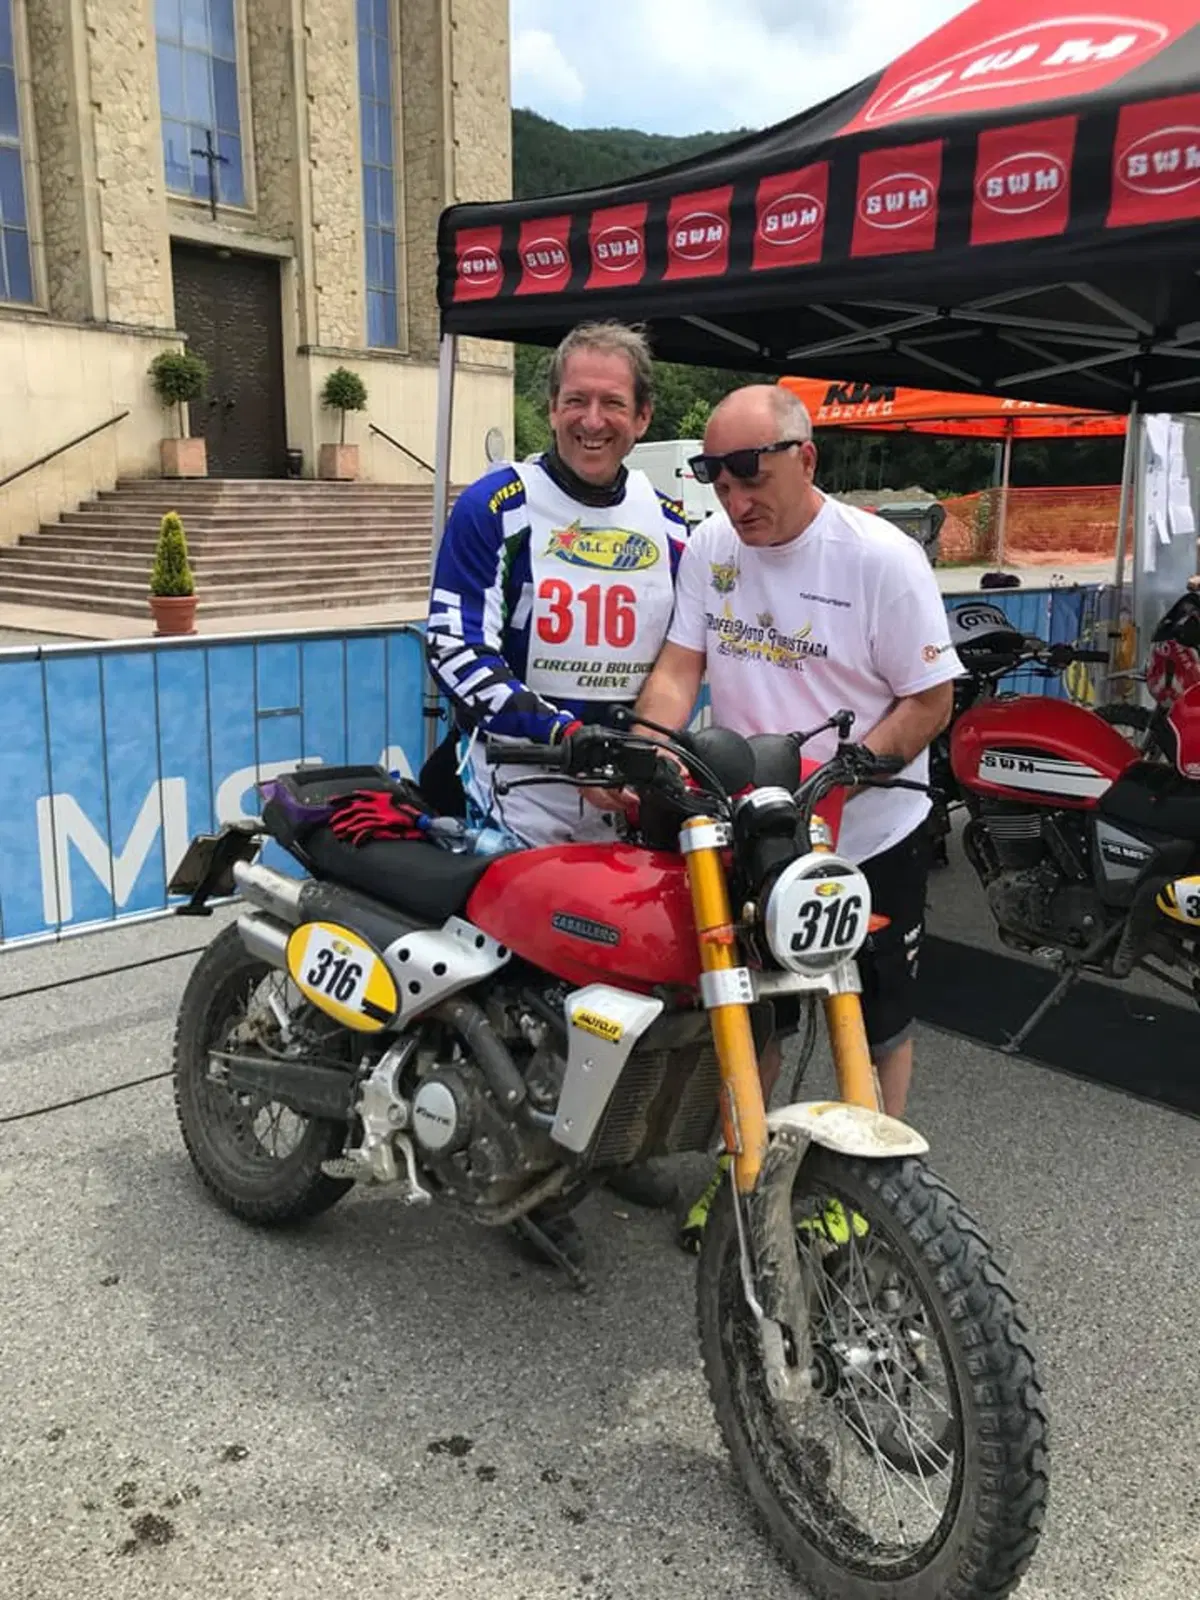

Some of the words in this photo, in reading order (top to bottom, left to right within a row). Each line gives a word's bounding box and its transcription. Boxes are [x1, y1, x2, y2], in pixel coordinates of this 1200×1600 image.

[986, 169, 1059, 198] SWM
[866, 188, 928, 214] SWM
[765, 207, 817, 233] SWM
[675, 225, 723, 248] SWM
[525, 249, 565, 268] SWM
[597, 239, 639, 259] SWM
[462, 258, 498, 274] SWM
[536, 578, 637, 648] 316
[533, 659, 603, 674] CIRCOLO
[576, 674, 630, 688] CHIEVE
[984, 756, 1034, 773] SWM
[790, 895, 862, 952] 316
[307, 948, 363, 1001] 316
